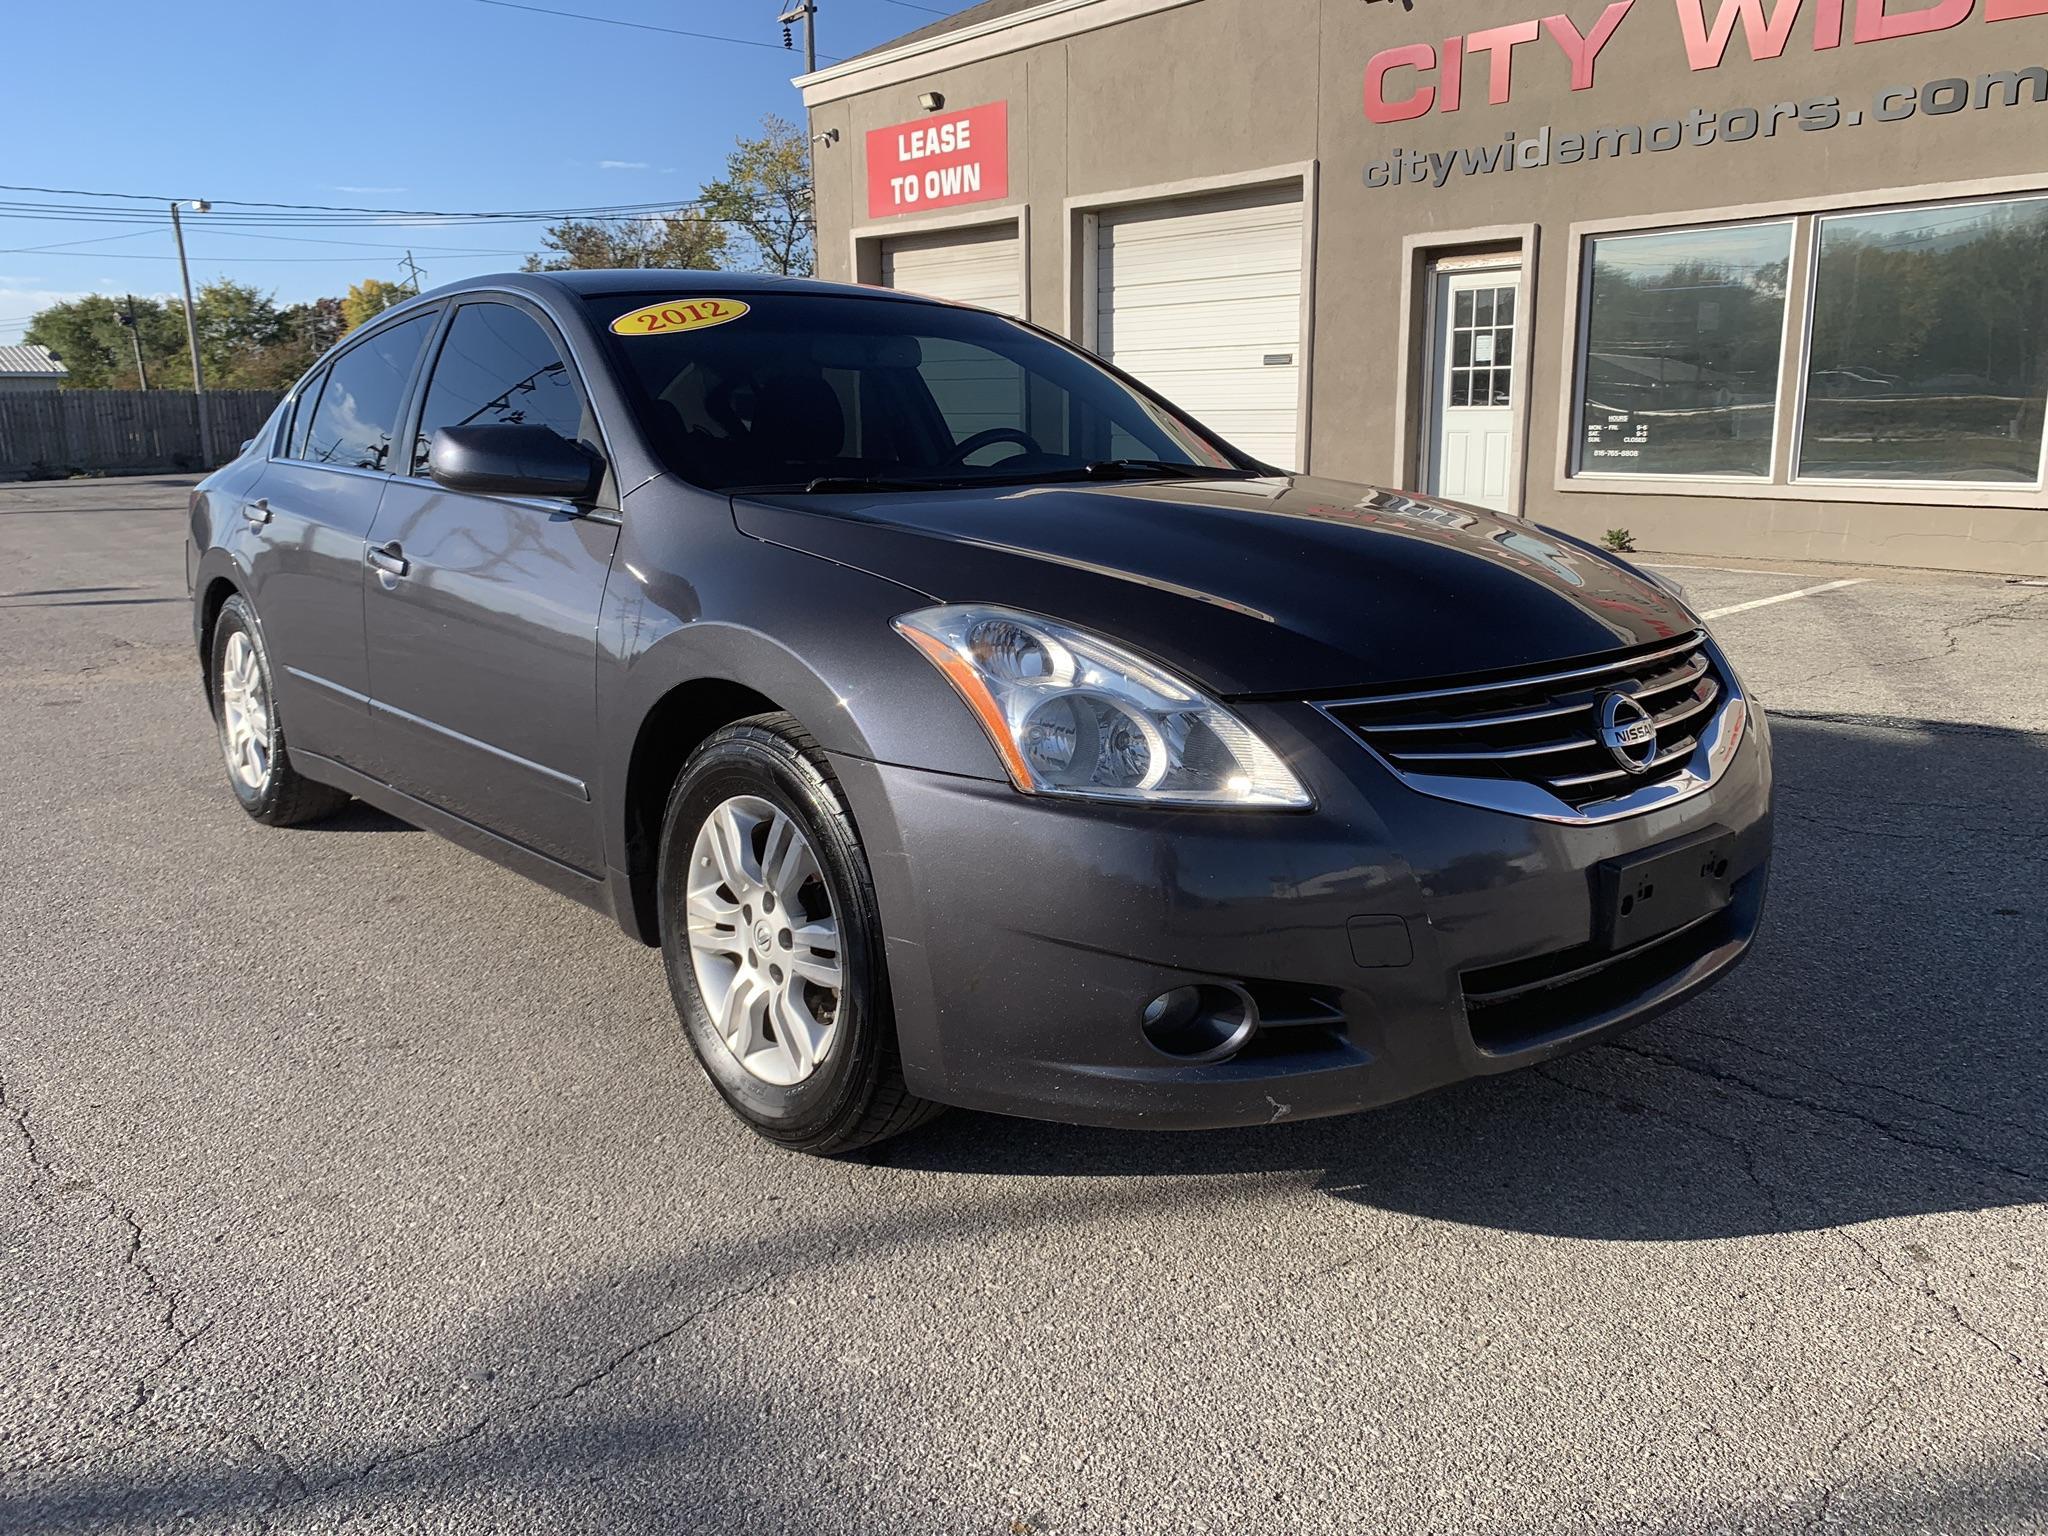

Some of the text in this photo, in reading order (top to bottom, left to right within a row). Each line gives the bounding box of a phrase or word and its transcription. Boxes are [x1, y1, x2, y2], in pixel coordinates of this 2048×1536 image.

[1363, 0, 2048, 124] CITY WI
[898, 120, 971, 162] LEASE
[1362, 66, 2048, 188] citywidemotors.com
[891, 162, 980, 205] TO OWN
[637, 301, 729, 331] 2012
